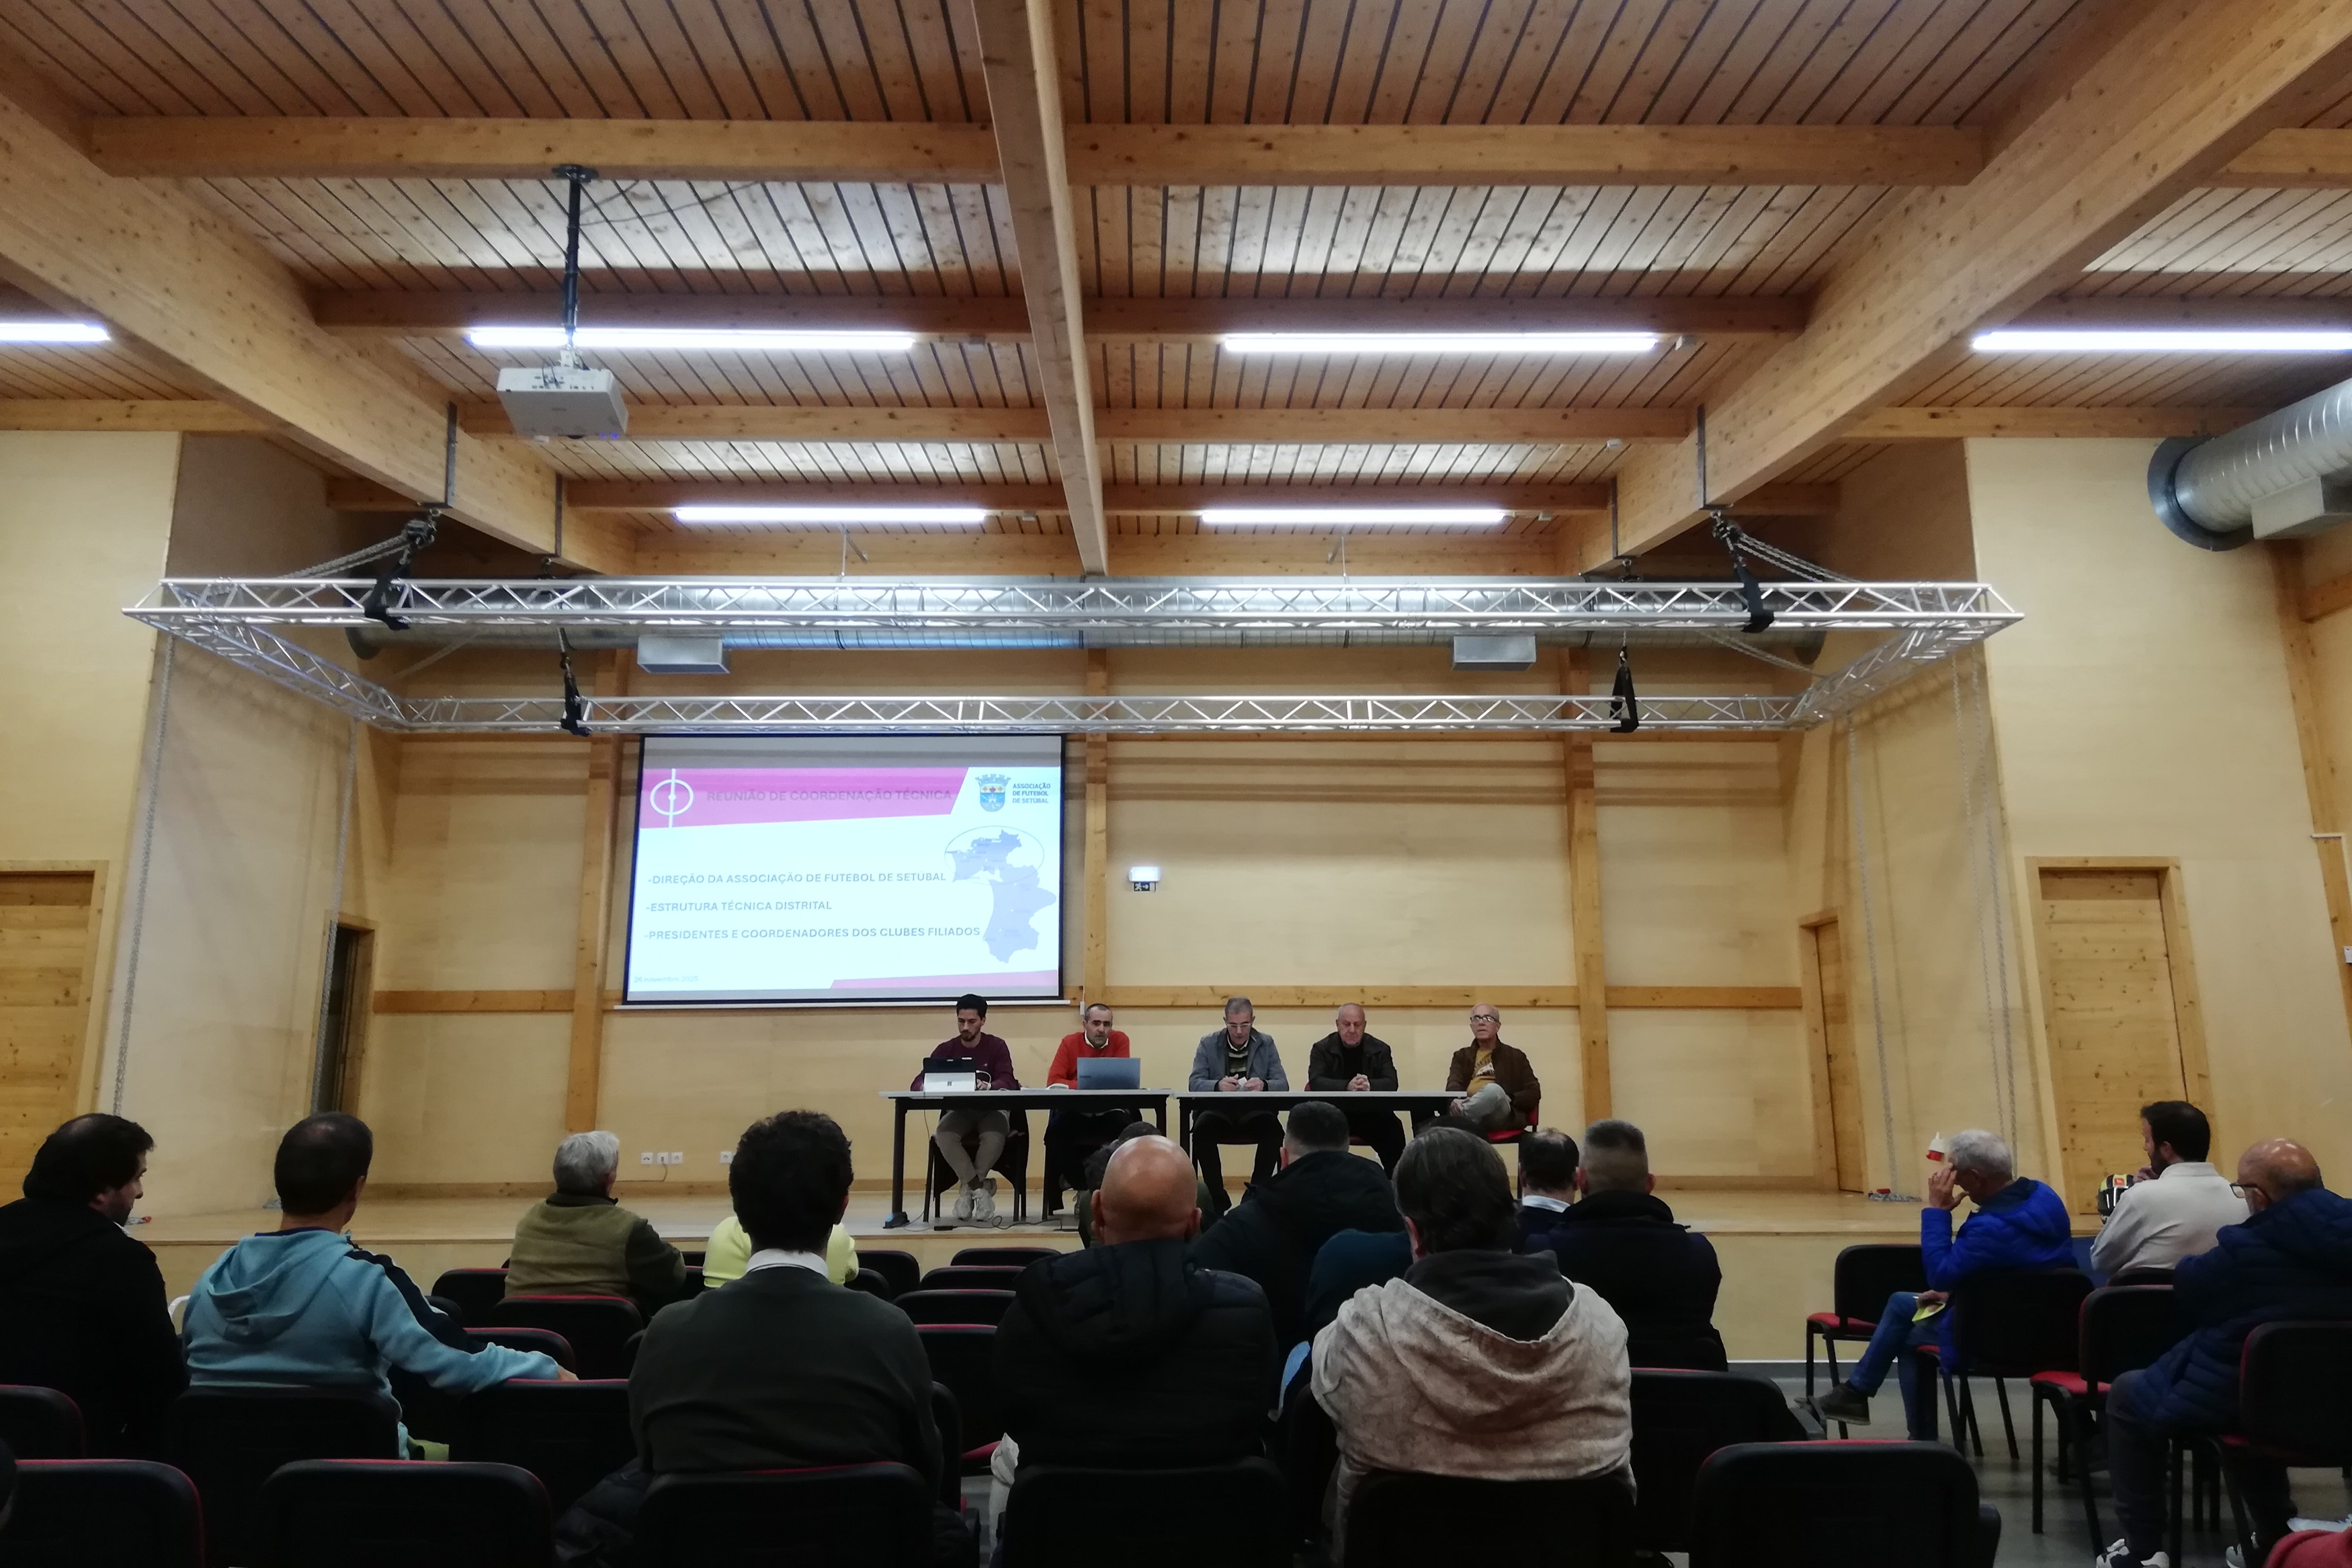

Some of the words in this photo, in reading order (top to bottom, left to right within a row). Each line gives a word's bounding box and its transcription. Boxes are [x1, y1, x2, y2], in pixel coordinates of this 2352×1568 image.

[707, 789, 766, 801] REUNIÃO
[769, 791, 787, 801] DE
[790, 789, 892, 802] COORDENAÇÃO
[648, 873, 704, 885] -DIREÇÃO
[708, 875, 723, 883] DA
[726, 872, 802, 884] ASSOCIAÇÃO
[806, 874, 821, 882] DE
[824, 873, 875, 882] FUTEBOL
[878, 873, 894, 881] DE
[896, 871, 946, 881] SETÚBAL
[646, 902, 718, 912] -ESTRUTURA
[721, 900, 772, 911] TÉCNICA
[775, 901, 832, 910] DISTRITAL
[644, 930, 728, 940] -PRESIDENTES
[732, 930, 738, 938] E
[741, 928, 849, 938] COORDENADORES
[852, 928, 877, 937] DOS
[880, 927, 925, 936] CLUBES
[928, 927, 980, 936] FILIADOS
